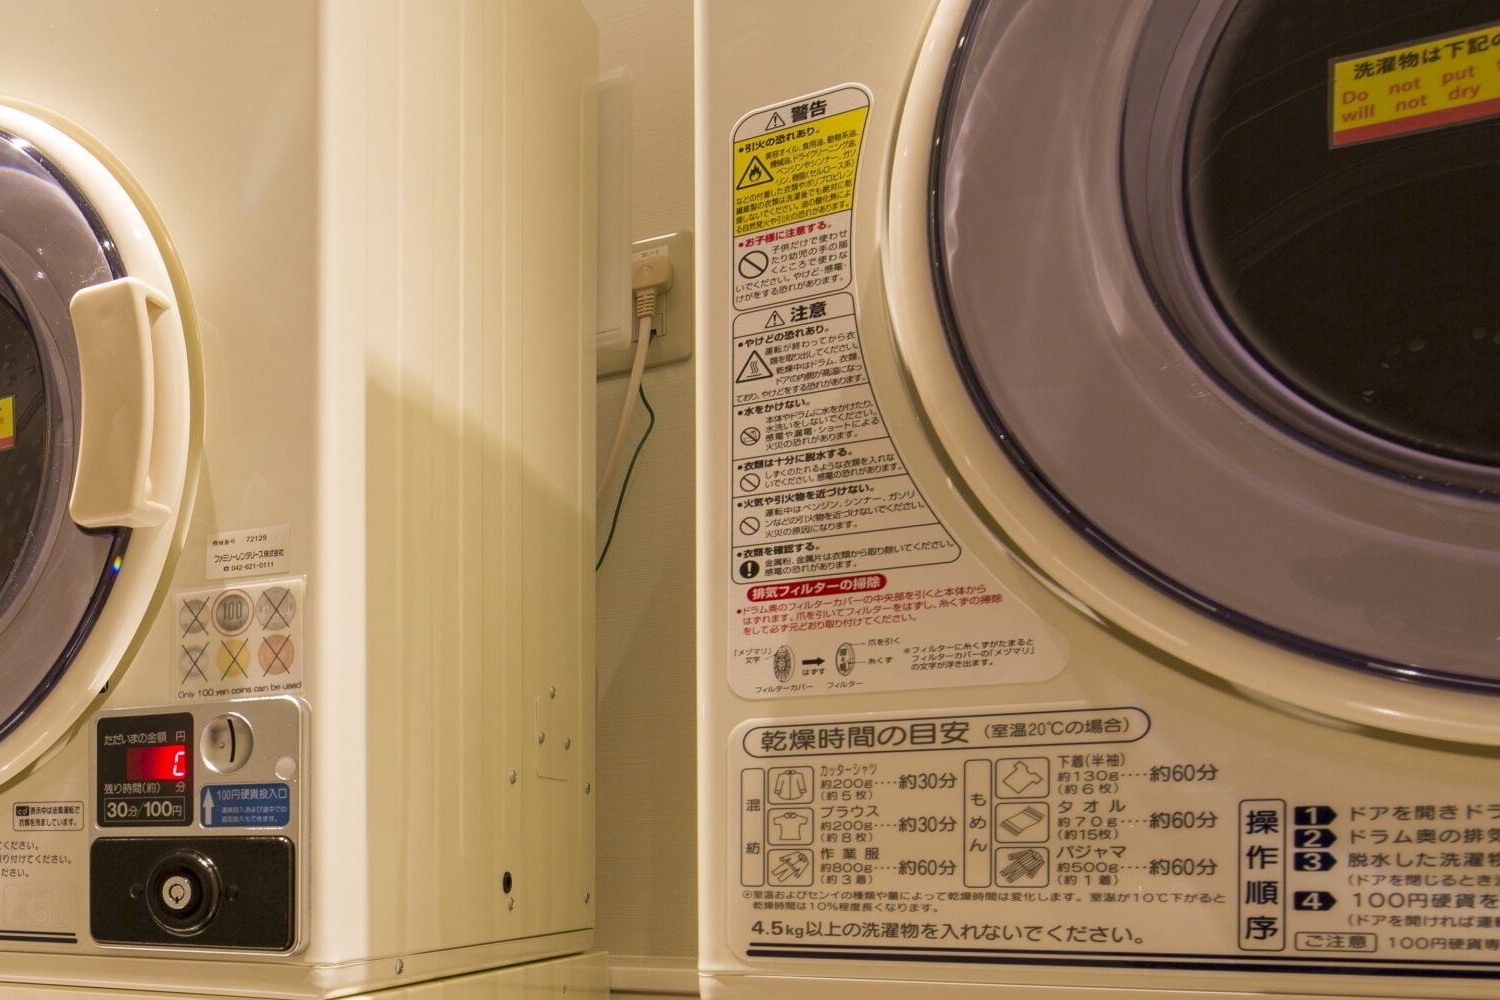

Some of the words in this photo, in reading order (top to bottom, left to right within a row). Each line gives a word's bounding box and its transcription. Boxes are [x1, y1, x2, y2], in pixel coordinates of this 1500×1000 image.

[1342, 90, 1369, 105] Do
[1389, 77, 1422, 96] not
[1442, 66, 1476, 87] put
[790, 100, 828, 123] 警告
[1341, 104, 1375, 123] will
[1395, 95, 1428, 112] not
[1448, 84, 1481, 101] dry
[744, 127, 820, 154] 引火の恐れあり。
[744, 221, 832, 248] お子様に注意する。
[771, 230, 848, 254] 子供だけで使わせ
[771, 240, 848, 264] たり幼児の手の届
[771, 251, 847, 274] くところで使わな
[735, 275, 844, 303] けがをする恐れがあります。
[790, 301, 827, 322] 注意
[745, 325, 830, 348] やけどの恐れあり。
[764, 332, 856, 355] 運転が終わってから衣
[744, 399, 811, 417] 水をかけない。
[765, 431, 858, 450] 火災の恐れがあります。
[743, 448, 853, 472] 衣類は十分に脱水する。
[743, 484, 875, 509] 火気や引火物を近づけない。
[245, 534, 268, 543] 72129
[764, 520, 858, 539] 火災の原因になります。
[213, 548, 284, 563] ファミリーレンタリース株式会社
[743, 543, 820, 559] 衣類を確認する。
[231, 562, 274, 572] 042-621-0111
[764, 560, 858, 577] 感電の恐れがあります。
[752, 576, 881, 600] 排気フィルターの掃除
[742, 584, 987, 615] ドラム奥のフィルターカバーの中央部を引くと本体から
[223, 601, 243, 621] 100
[743, 613, 917, 636] をして必ず元どおり取り付けてください。
[178, 689, 195, 699] Only
[198, 688, 215, 697] 100
[215, 688, 230, 697] yen
[231, 686, 252, 695] coins
[254, 684, 269, 692] can
[270, 682, 281, 690] be
[283, 680, 302, 689] used
[104, 730, 167, 746] ただいまの金額
[175, 730, 186, 743] 円
[760, 721, 970, 753] 乾燥時間の目安
[898, 772, 958, 790] 約30分
[1150, 763, 1218, 782] 約60分
[175, 781, 186, 793] 分
[217, 787, 287, 801] 100円硬貨投入口
[820, 805, 880, 819] ブラウス
[1057, 799, 1126, 814] タオル
[898, 816, 958, 833] 約30分
[968, 792, 987, 852] もめん
[1150, 811, 1218, 829] 約60分
[820, 848, 880, 860] 作業服
[1056, 846, 1127, 859] パジャマ
[898, 859, 957, 876] 約60分
[1150, 858, 1218, 876] 約60分
[1245, 809, 1279, 940] 操作順序
[750, 920, 1145, 945] 4.5kg以上の洗濯物を入れないでください。
[1305, 934, 1367, 949] ご注意
